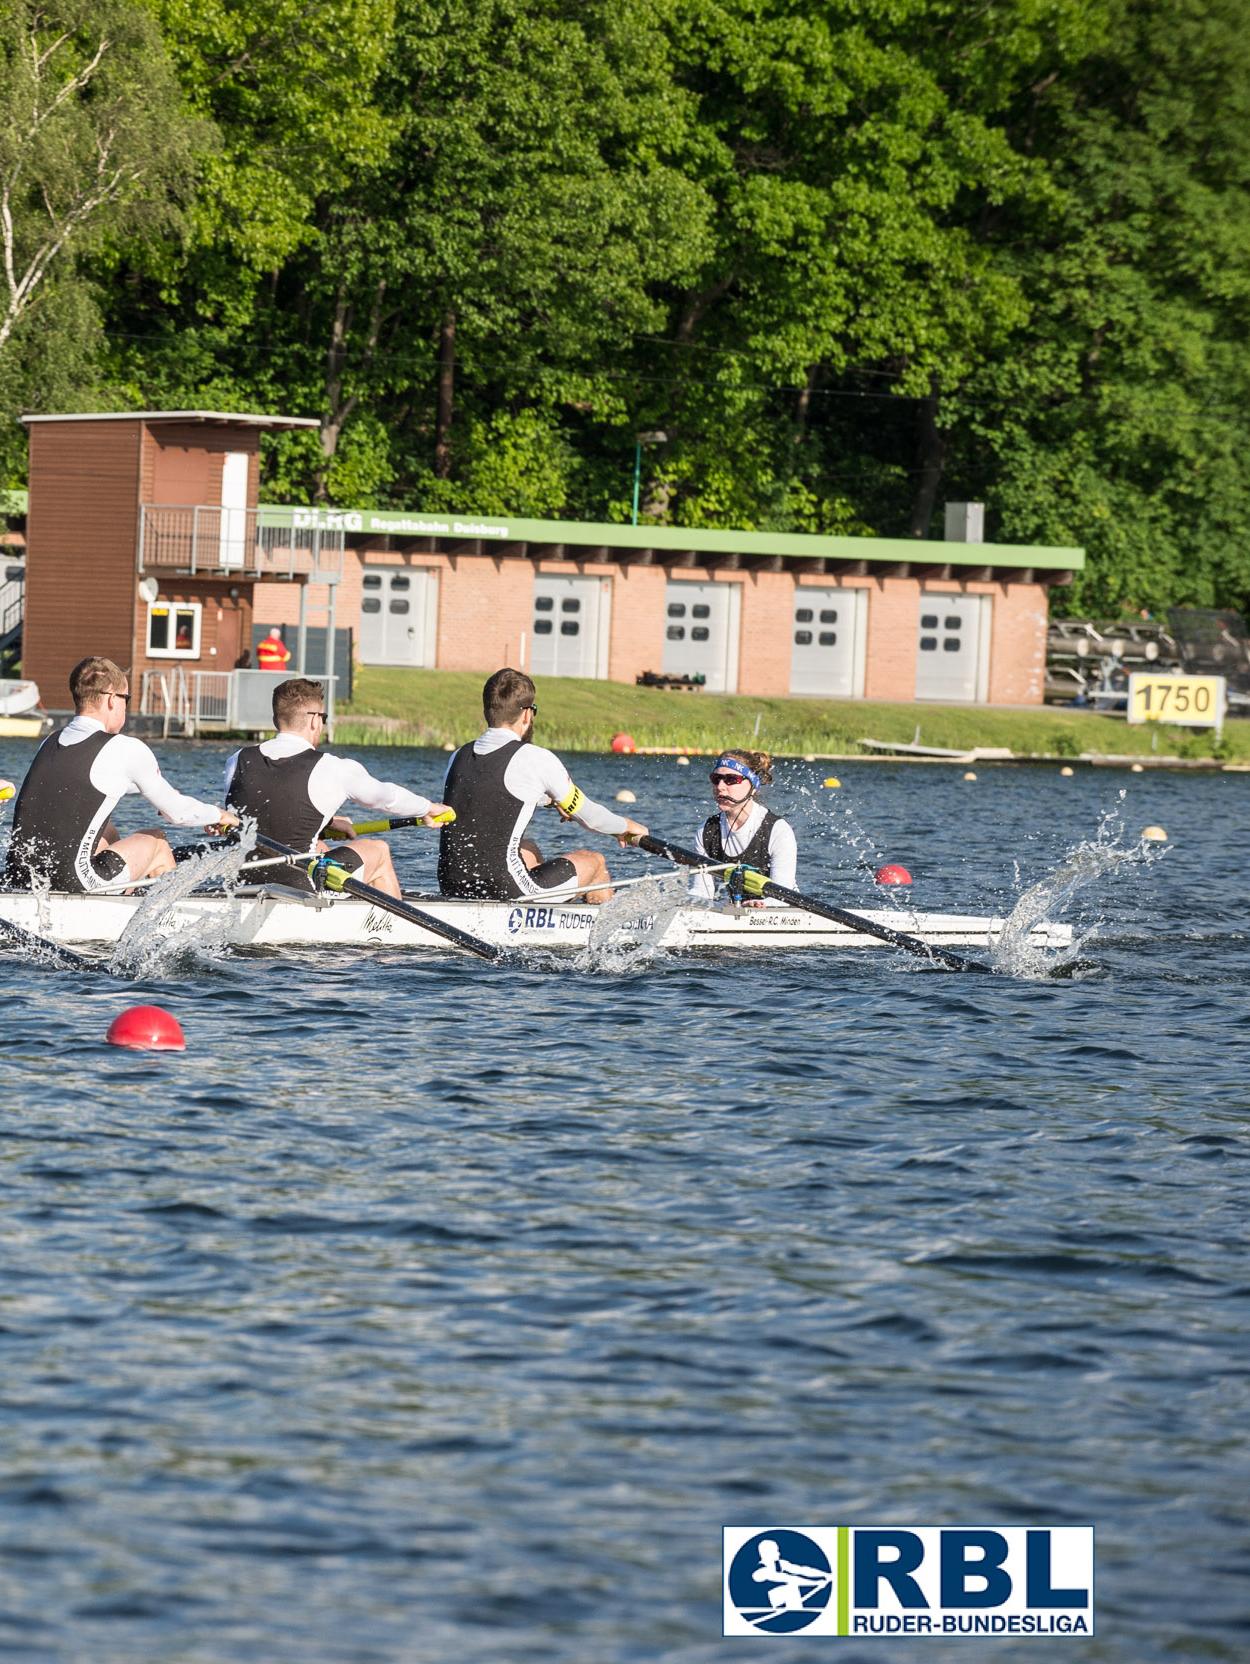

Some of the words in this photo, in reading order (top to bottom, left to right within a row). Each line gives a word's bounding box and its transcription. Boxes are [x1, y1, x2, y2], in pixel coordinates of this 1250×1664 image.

[293, 507, 363, 531] DLRG
[370, 517, 449, 533] Regattabahn
[453, 522, 509, 538] Duisburg
[1136, 684, 1210, 712] 1750
[524, 908, 556, 929] RBL
